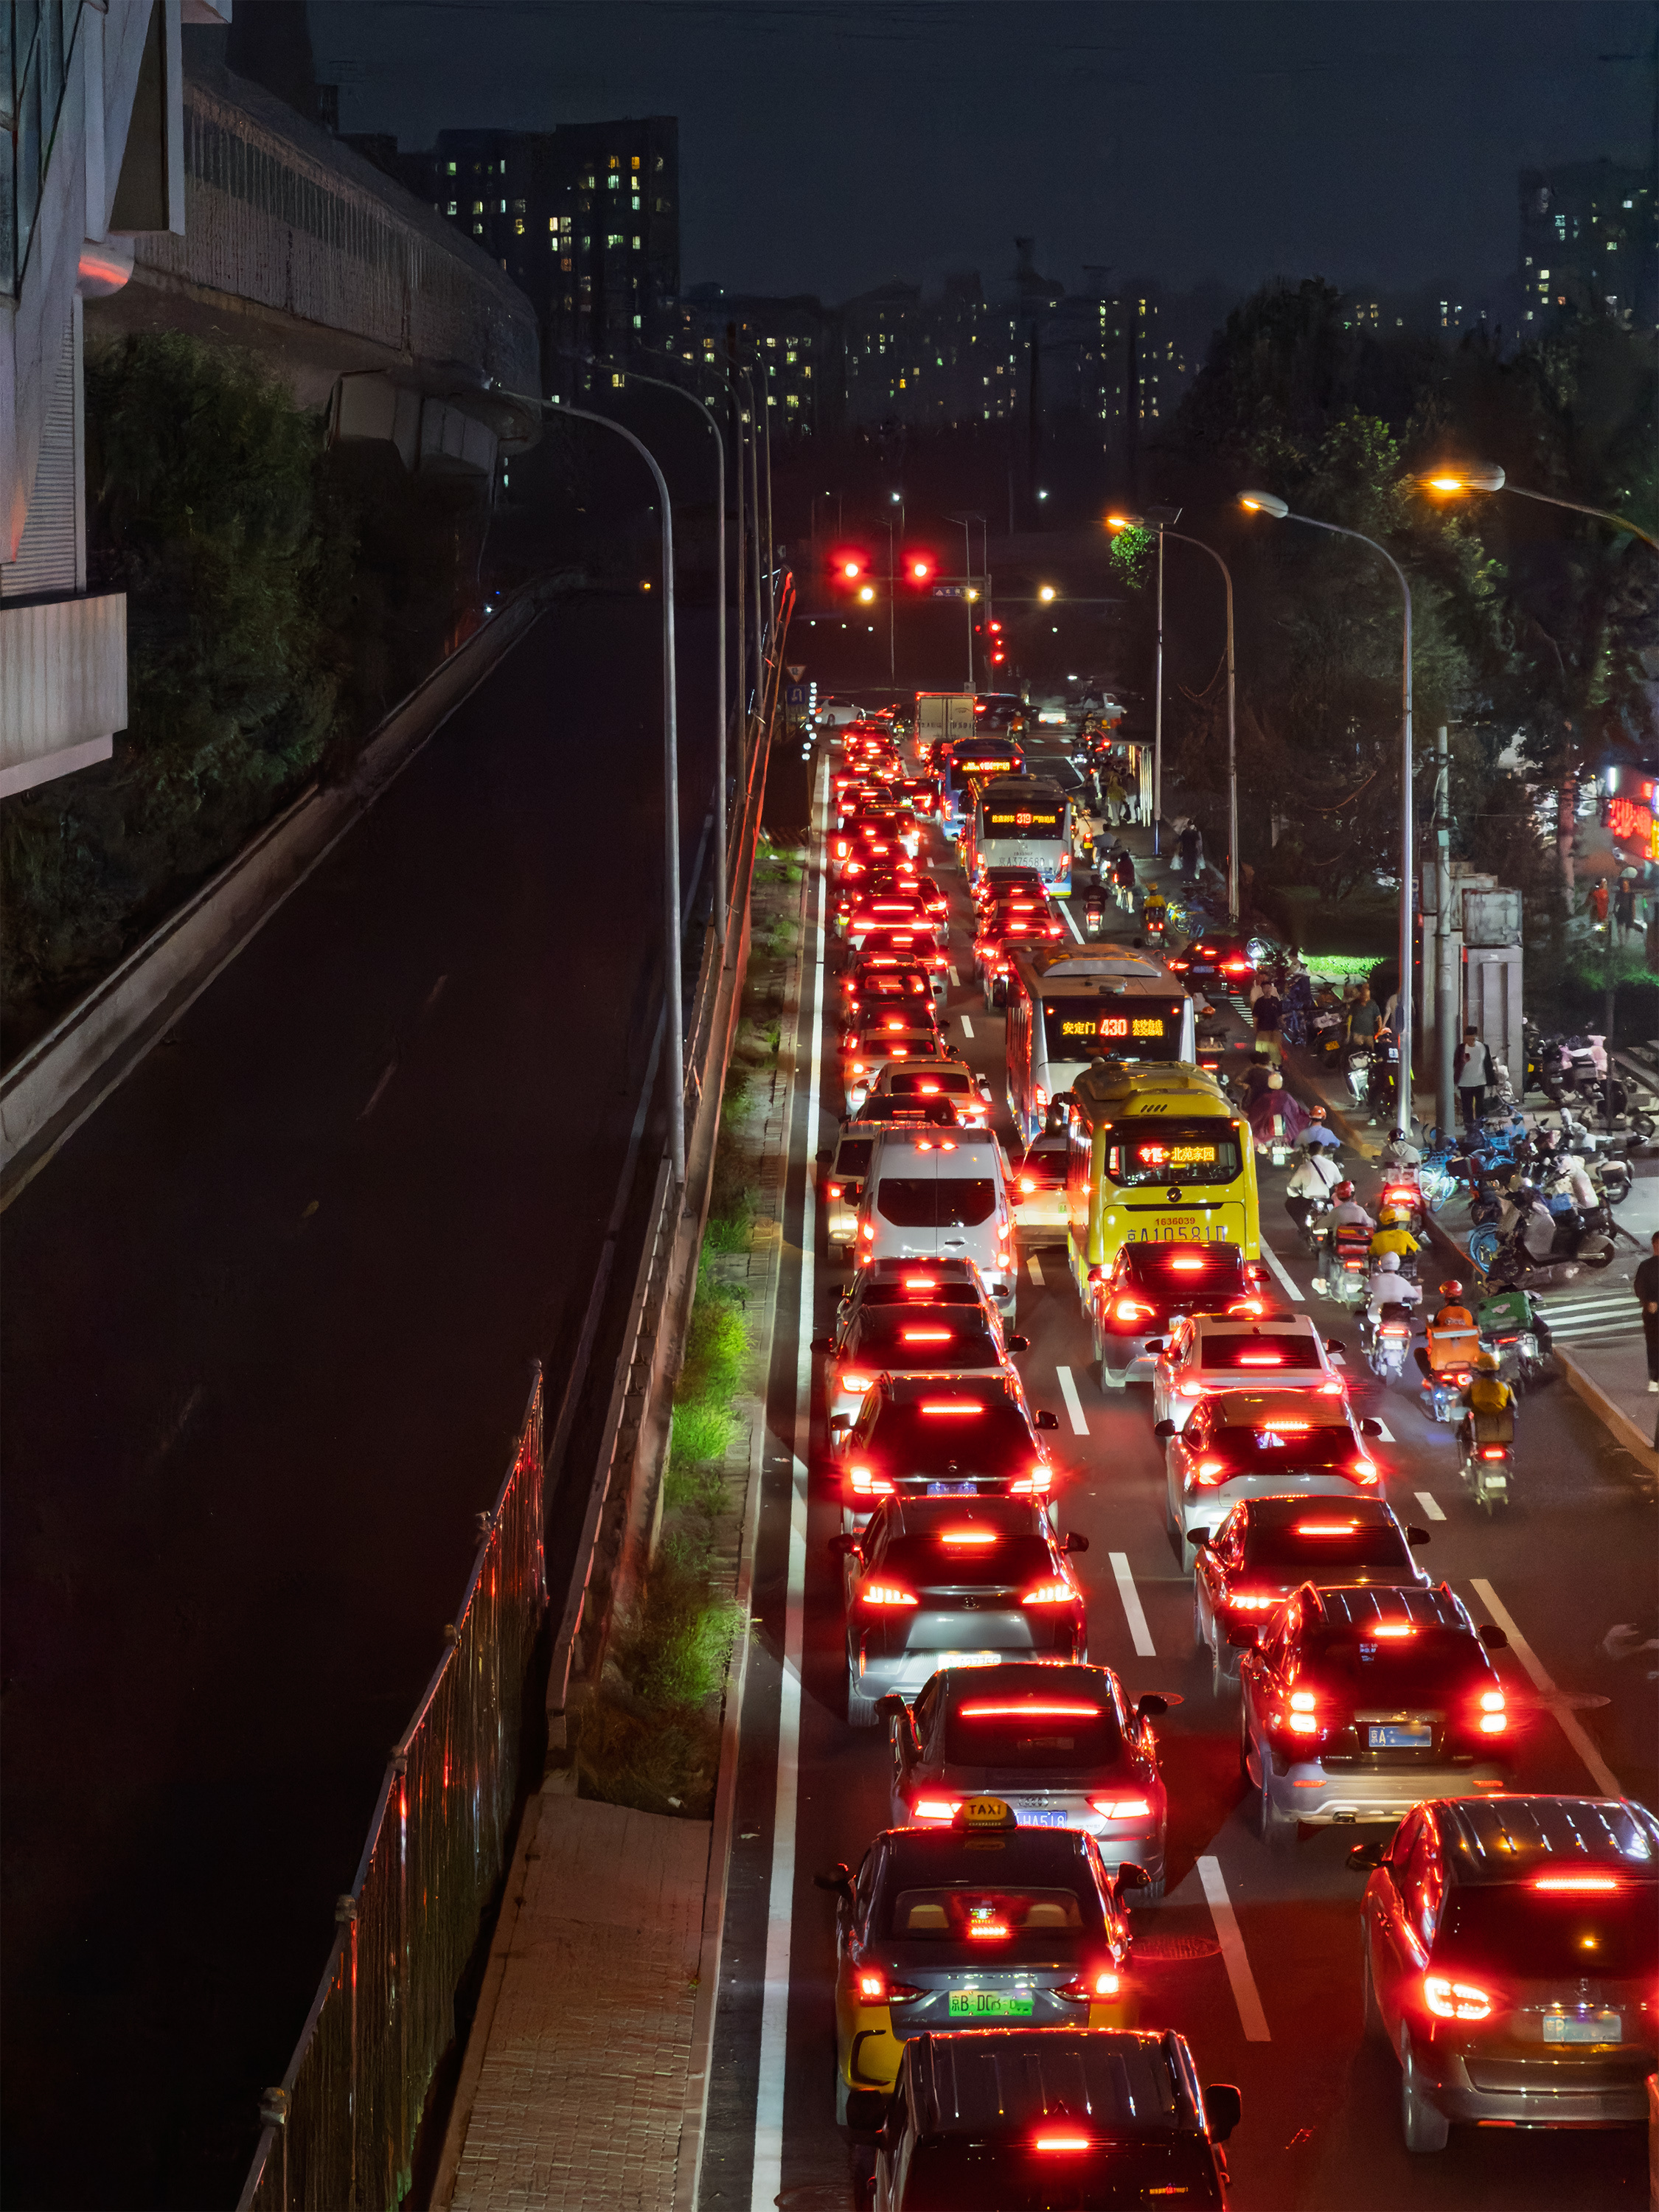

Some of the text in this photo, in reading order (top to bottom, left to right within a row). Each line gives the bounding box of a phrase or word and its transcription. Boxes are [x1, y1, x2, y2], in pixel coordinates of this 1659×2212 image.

[1017, 813, 1032, 824] 319
[1062, 1019, 1127, 1036] 安定门 430
[1171, 1147, 1214, 1161] 北苑家园
[1155, 1217, 1195, 1225] 1636039
[969, 1804, 1001, 1815] TAXI
